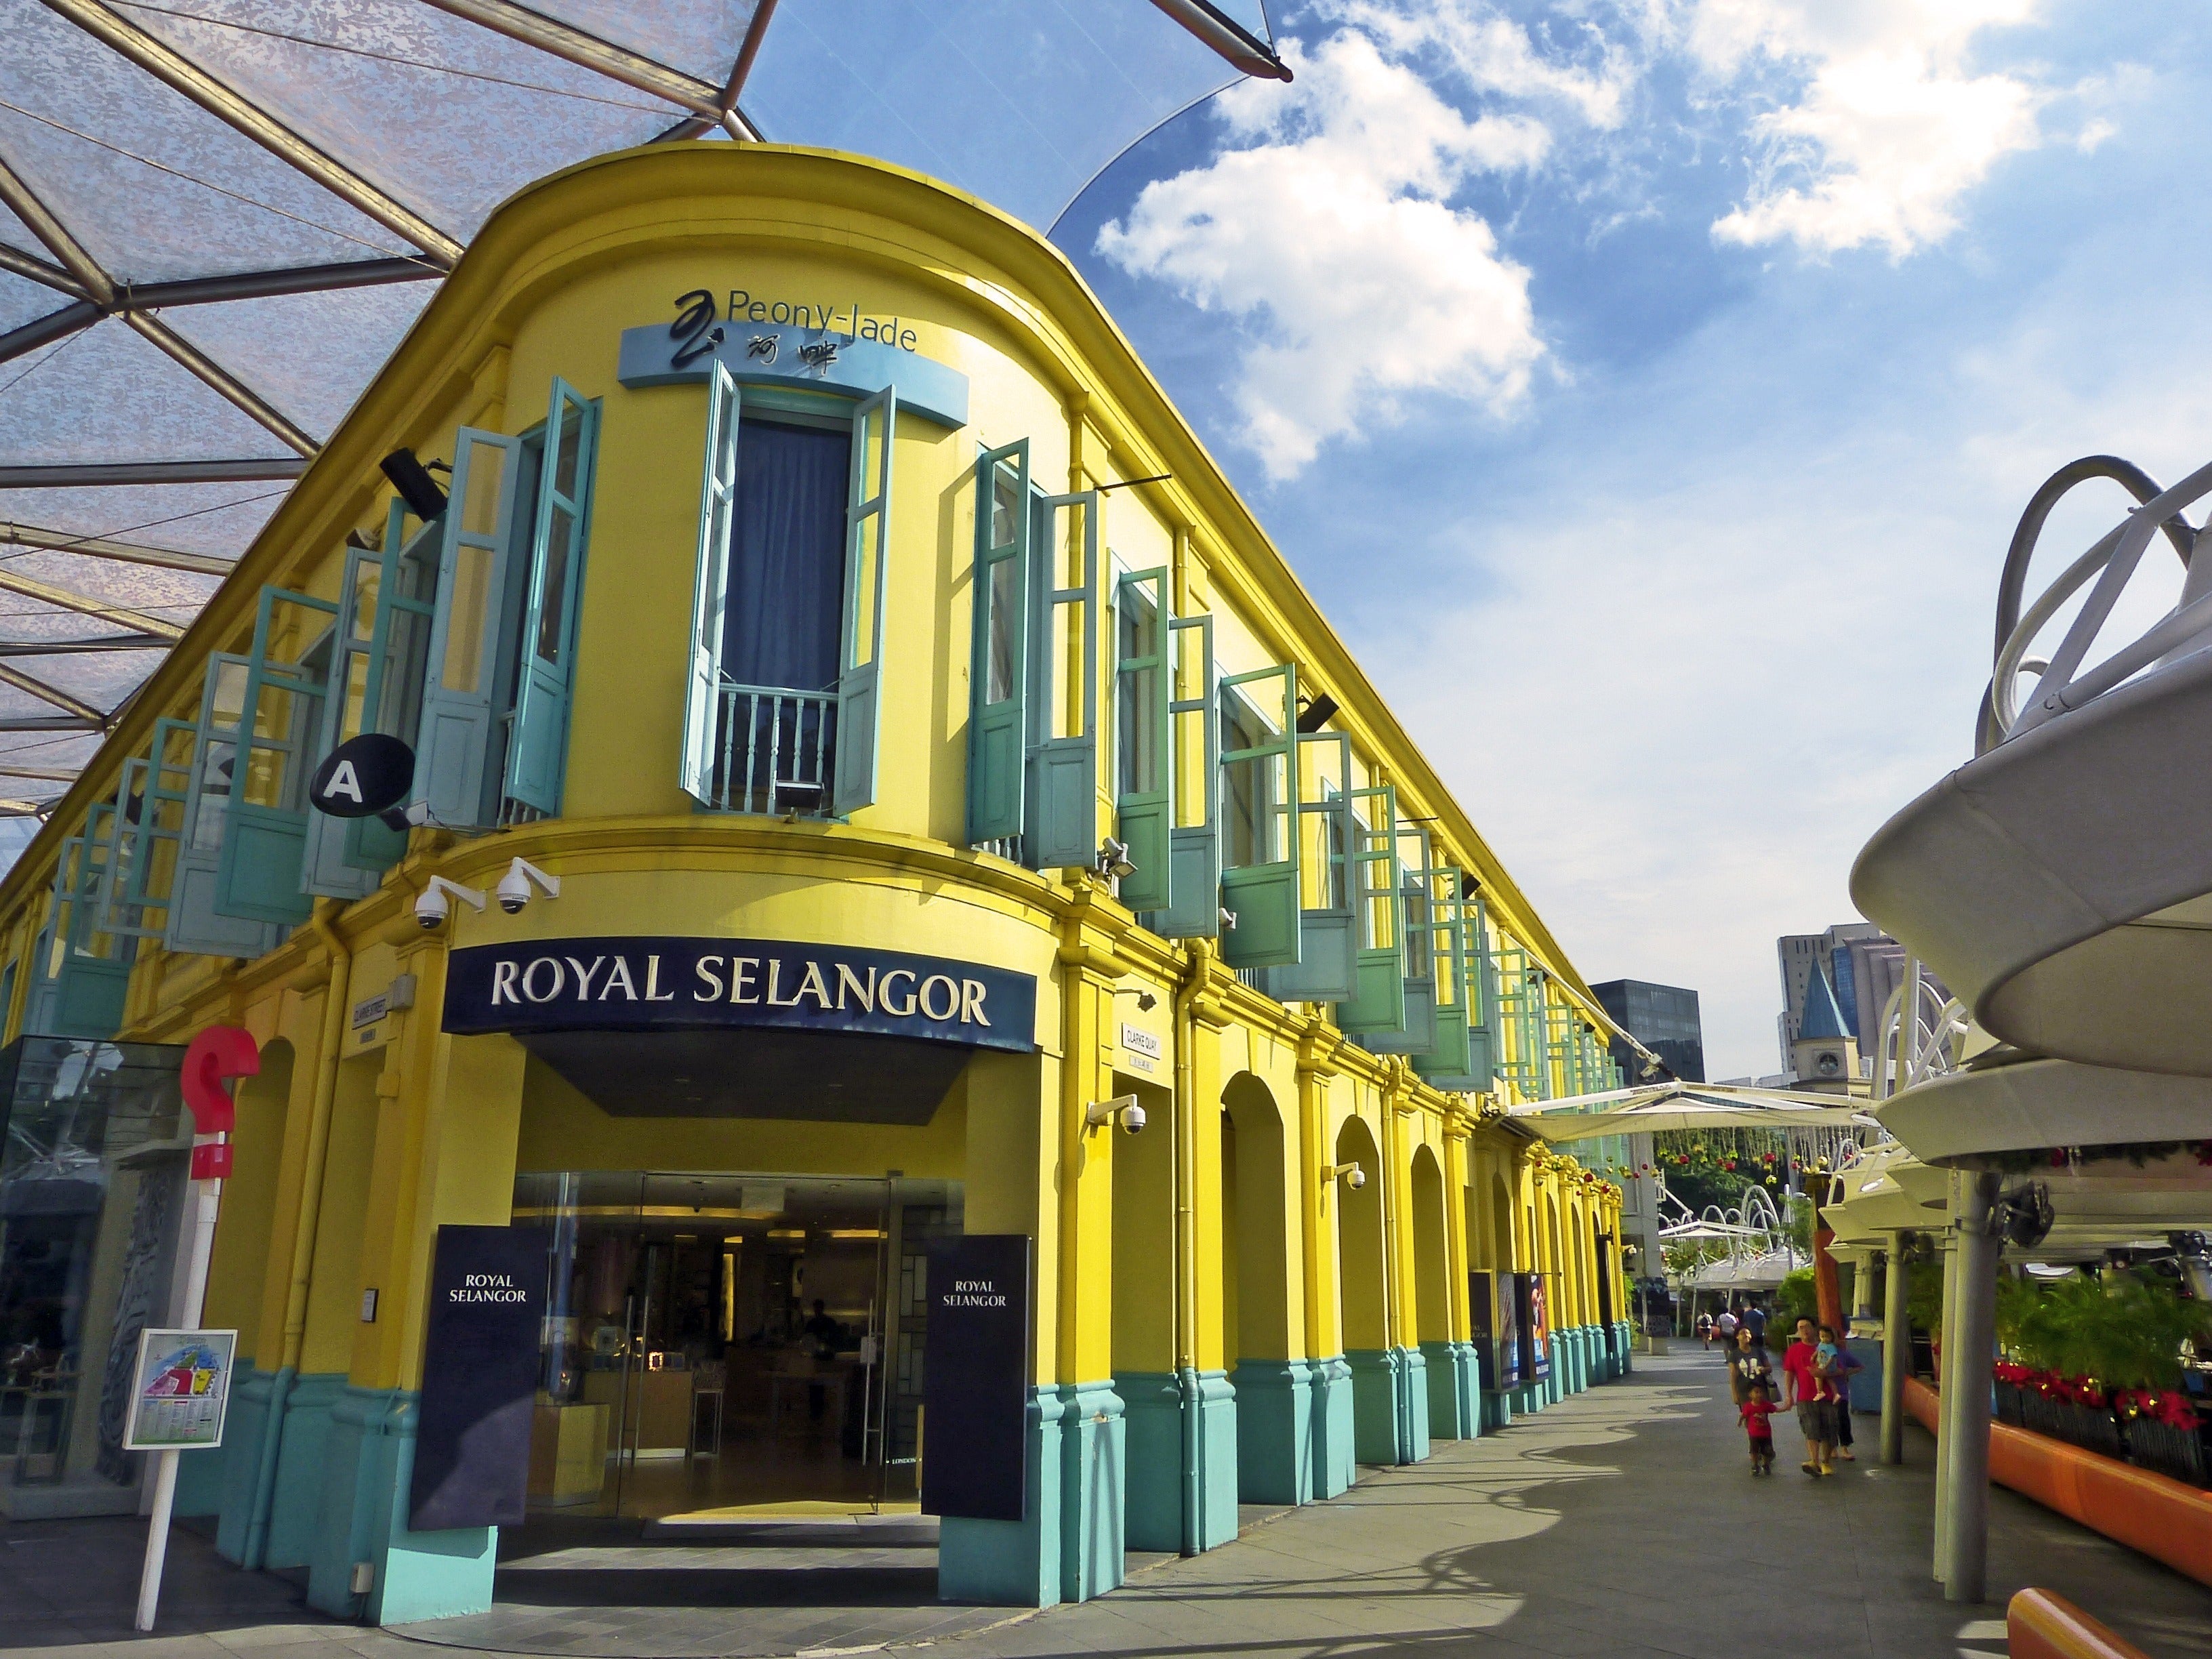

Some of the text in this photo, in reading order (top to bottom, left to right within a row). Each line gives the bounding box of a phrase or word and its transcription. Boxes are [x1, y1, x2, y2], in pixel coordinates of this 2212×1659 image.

[727, 289, 917, 352] Peony-Jade
[323, 760, 363, 803] A
[491, 955, 992, 1027] ROYAL SELANGOR
[465, 1274, 514, 1288] ROYAL
[955, 1280, 995, 1292] ROYAL
[449, 1289, 527, 1303] SELANGOR
[943, 1294, 1006, 1307] SELANGOR
